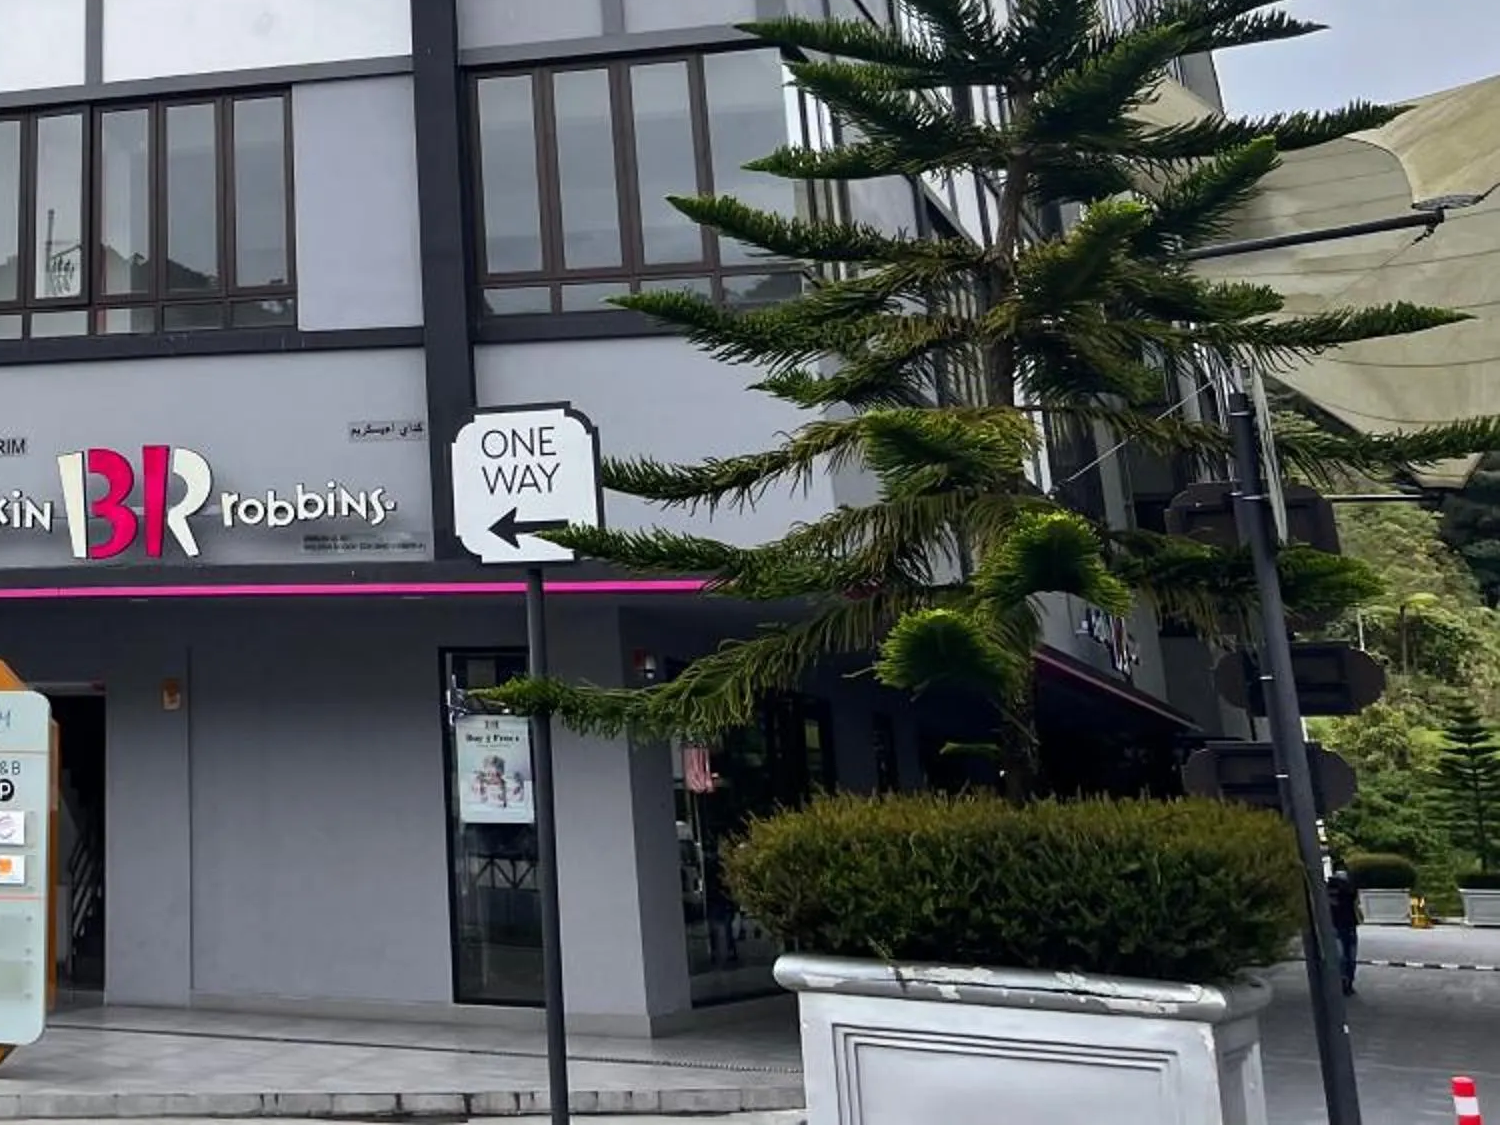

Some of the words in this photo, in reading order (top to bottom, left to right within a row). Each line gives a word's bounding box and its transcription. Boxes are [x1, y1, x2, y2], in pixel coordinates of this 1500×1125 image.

[481, 426, 557, 459] ONE
[481, 462, 561, 495] WAY
[57, 445, 212, 560] BR
